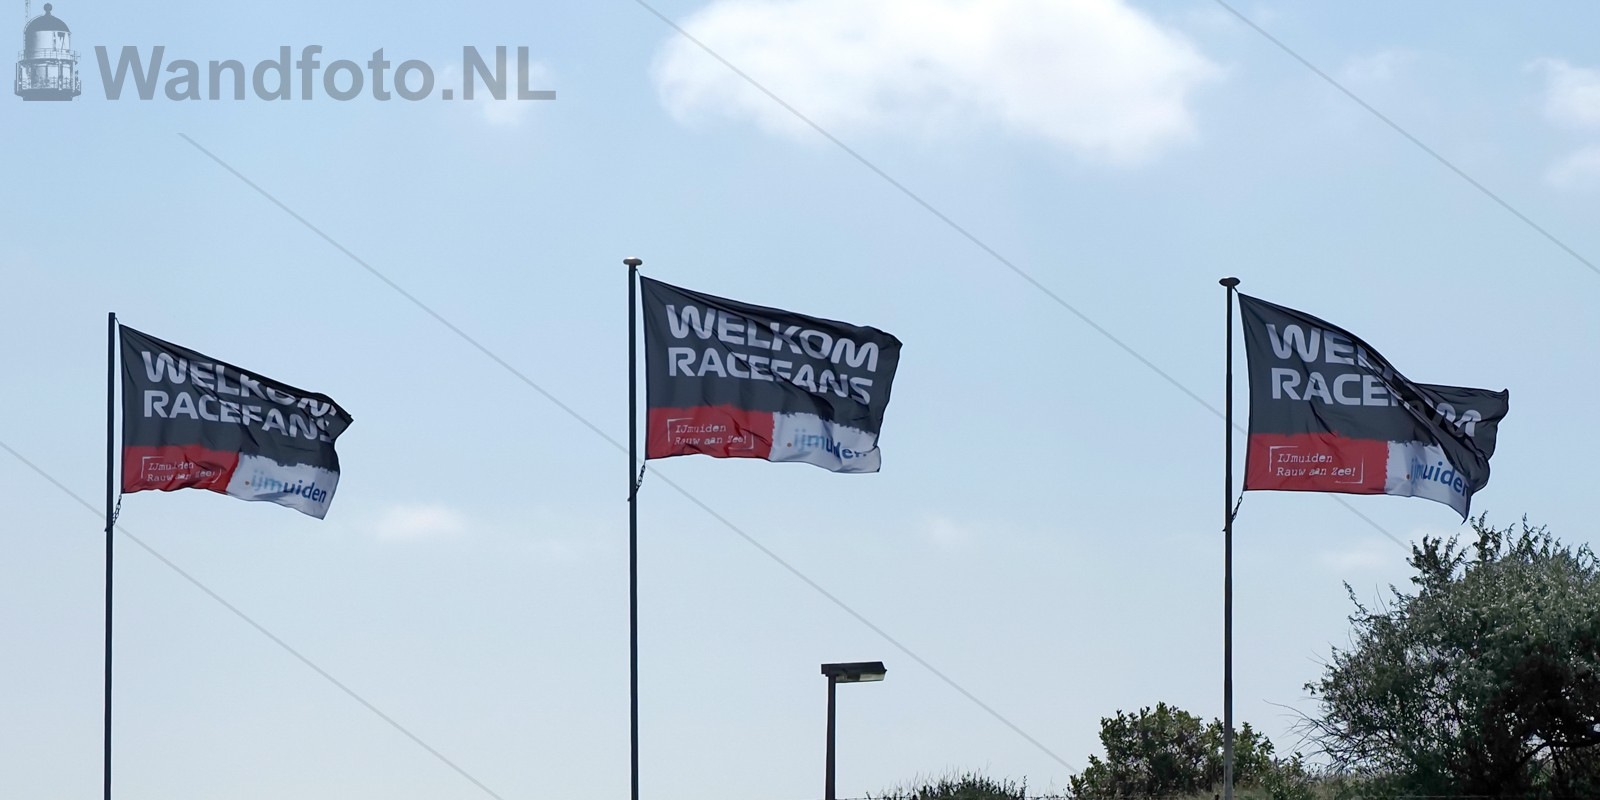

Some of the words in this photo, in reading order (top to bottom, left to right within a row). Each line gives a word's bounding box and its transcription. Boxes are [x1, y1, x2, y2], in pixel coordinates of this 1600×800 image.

[666, 304, 879, 372] WELKOM
[668, 346, 874, 405] RACEFANS
[1276, 467, 1306, 477] Rauw
[1309, 467, 1327, 476] aan
[1331, 467, 1356, 477] Zee!
[1277, 453, 1333, 463] IJmuiden
